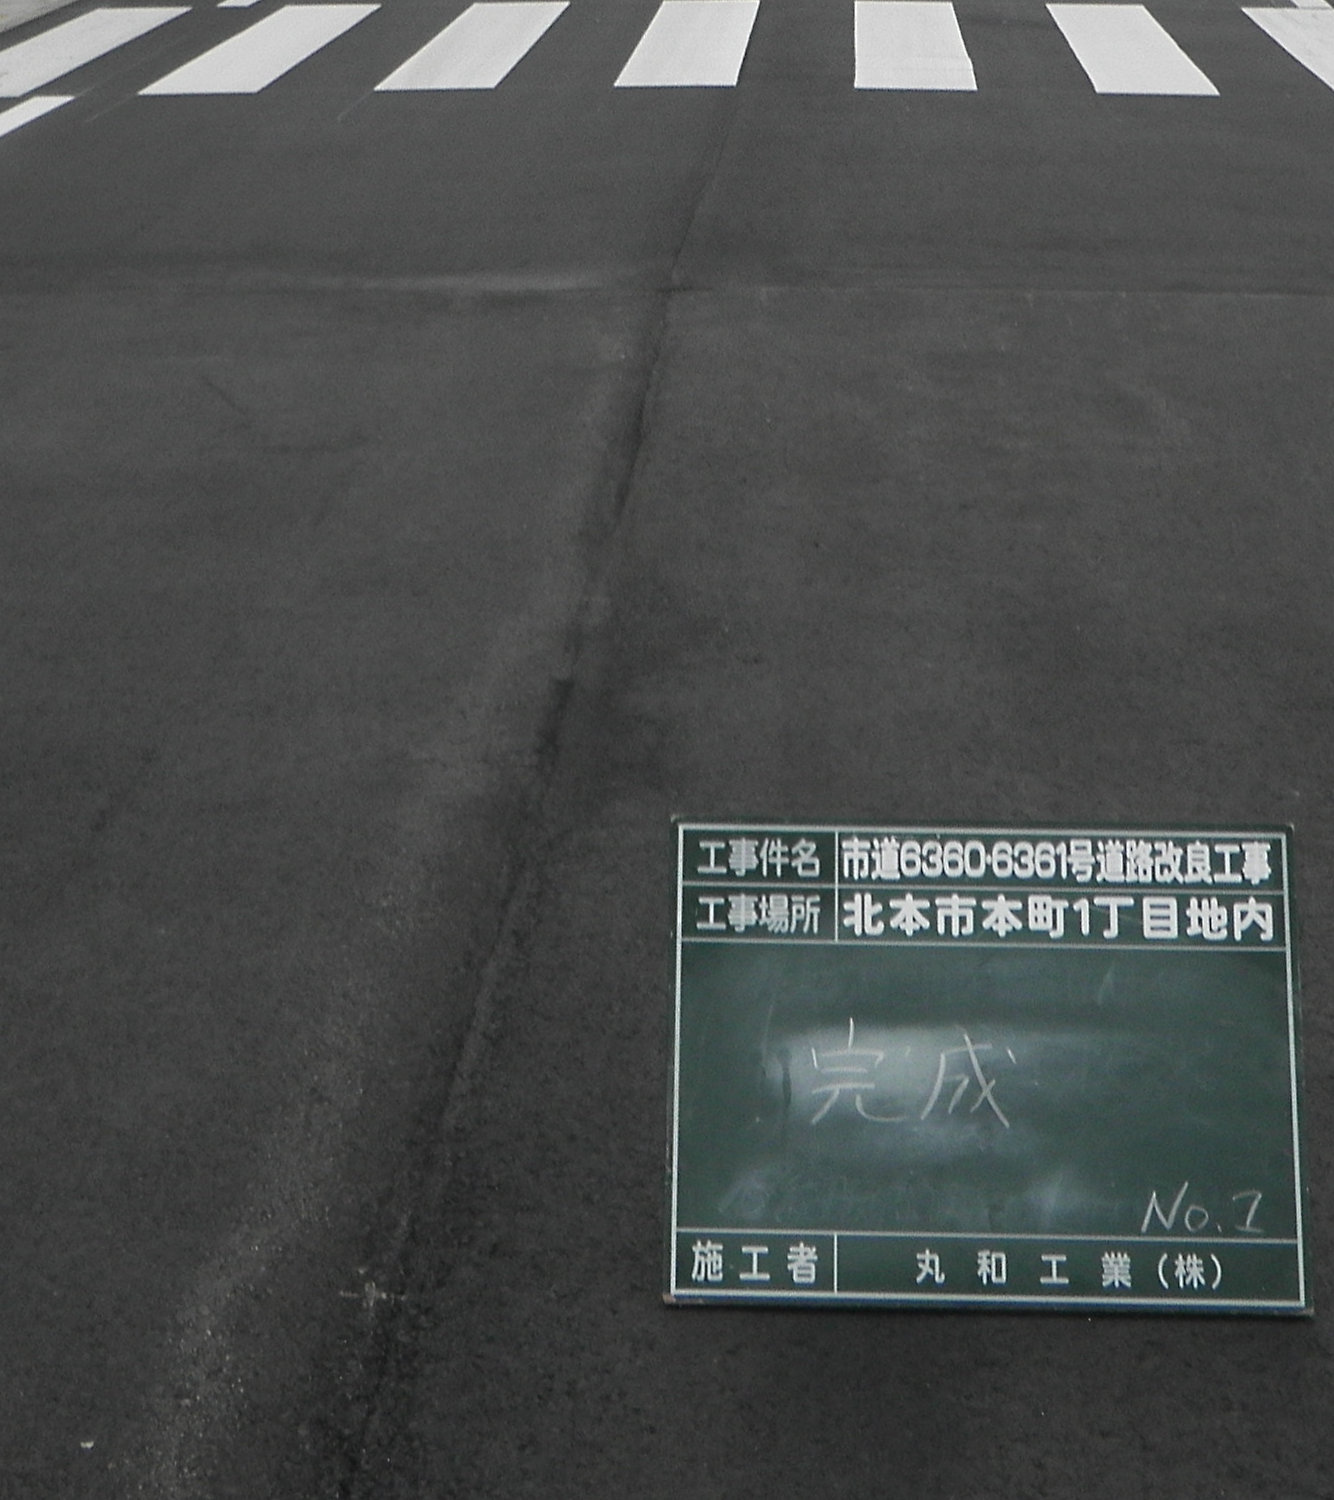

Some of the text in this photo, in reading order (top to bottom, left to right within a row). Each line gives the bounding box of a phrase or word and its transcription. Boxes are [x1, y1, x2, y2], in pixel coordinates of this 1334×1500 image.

[697, 836, 821, 879] 工事件名
[696, 893, 821, 934] 工事場所
[842, 892, 1274, 943] 北本市本町1丁目地内
[811, 1017, 1017, 1129] 完成
[1140, 1181, 1265, 1233] No.1
[691, 1240, 819, 1284] 施工者
